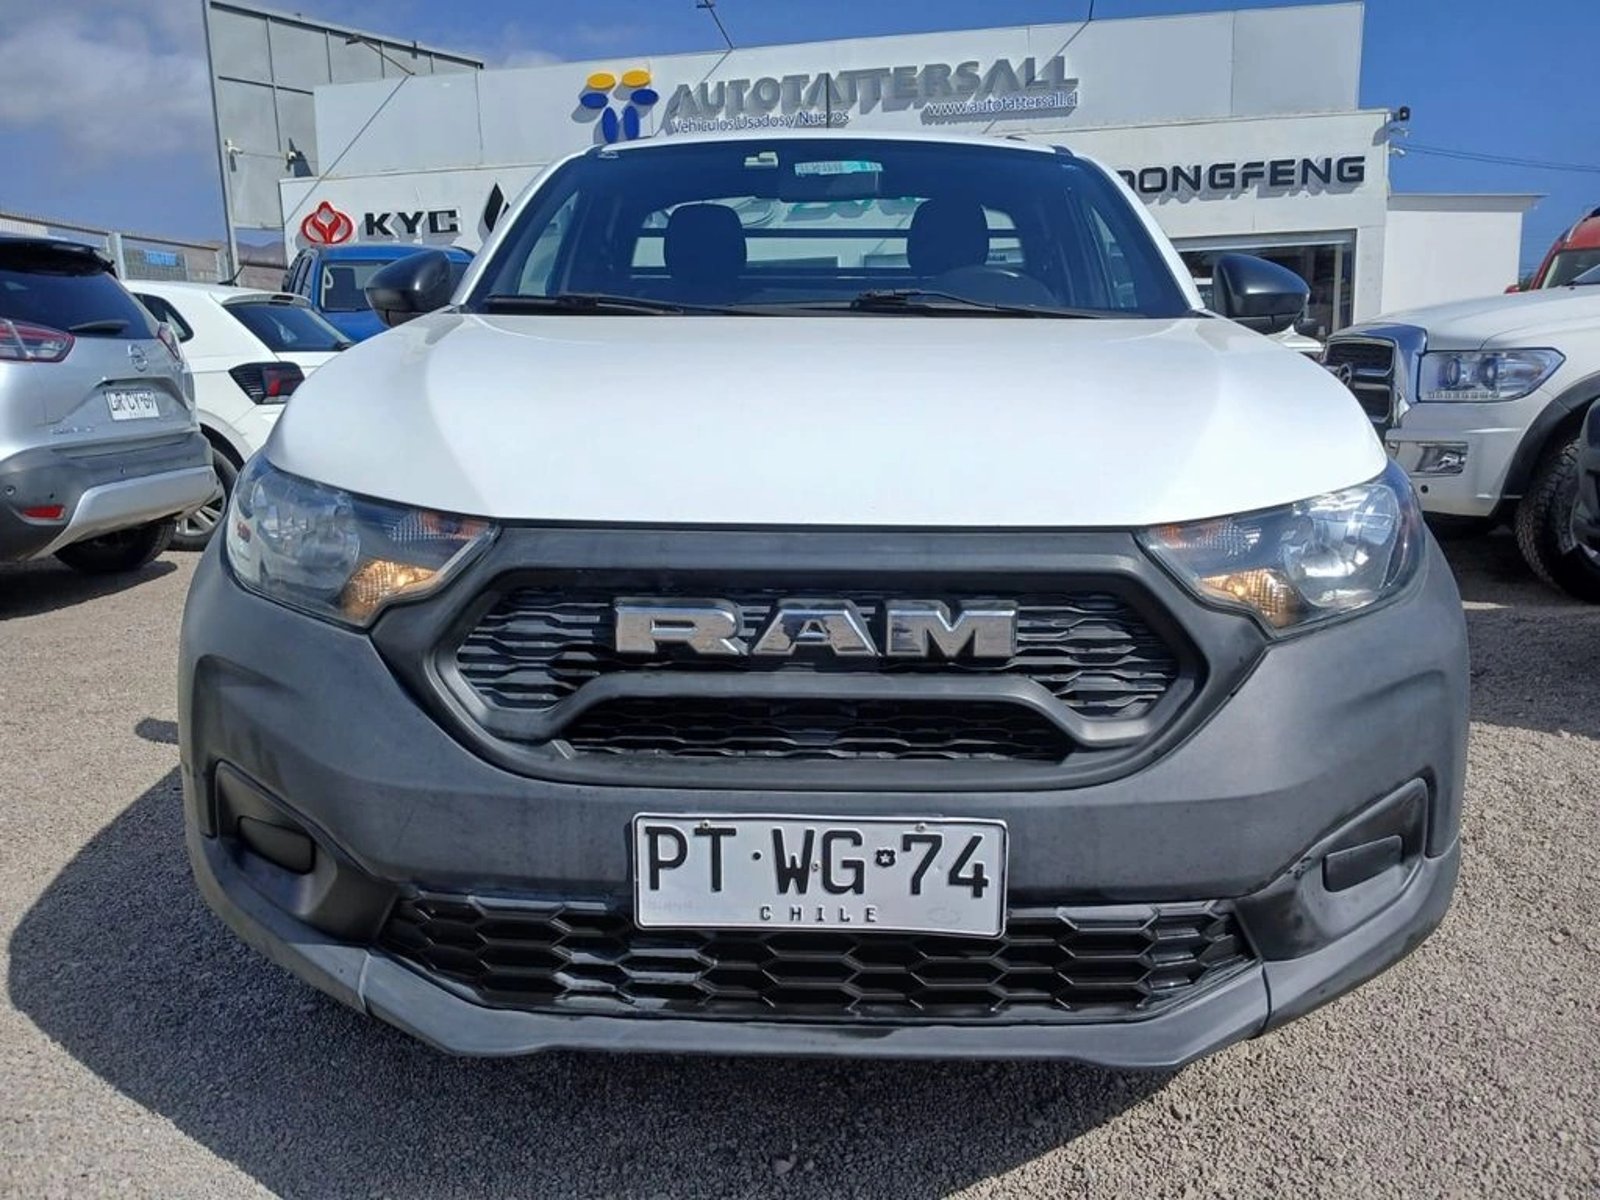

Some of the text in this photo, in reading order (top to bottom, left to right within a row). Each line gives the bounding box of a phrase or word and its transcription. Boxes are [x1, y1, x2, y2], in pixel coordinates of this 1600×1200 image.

[667, 55, 1079, 118] AUTOTATTERSALL
[928, 92, 1078, 116] www.autotattersall.cl
[799, 110, 850, 125] Nuevos
[364, 209, 460, 236] KYC
[614, 600, 1019, 657] RAM
[760, 905, 878, 924] CHILE
